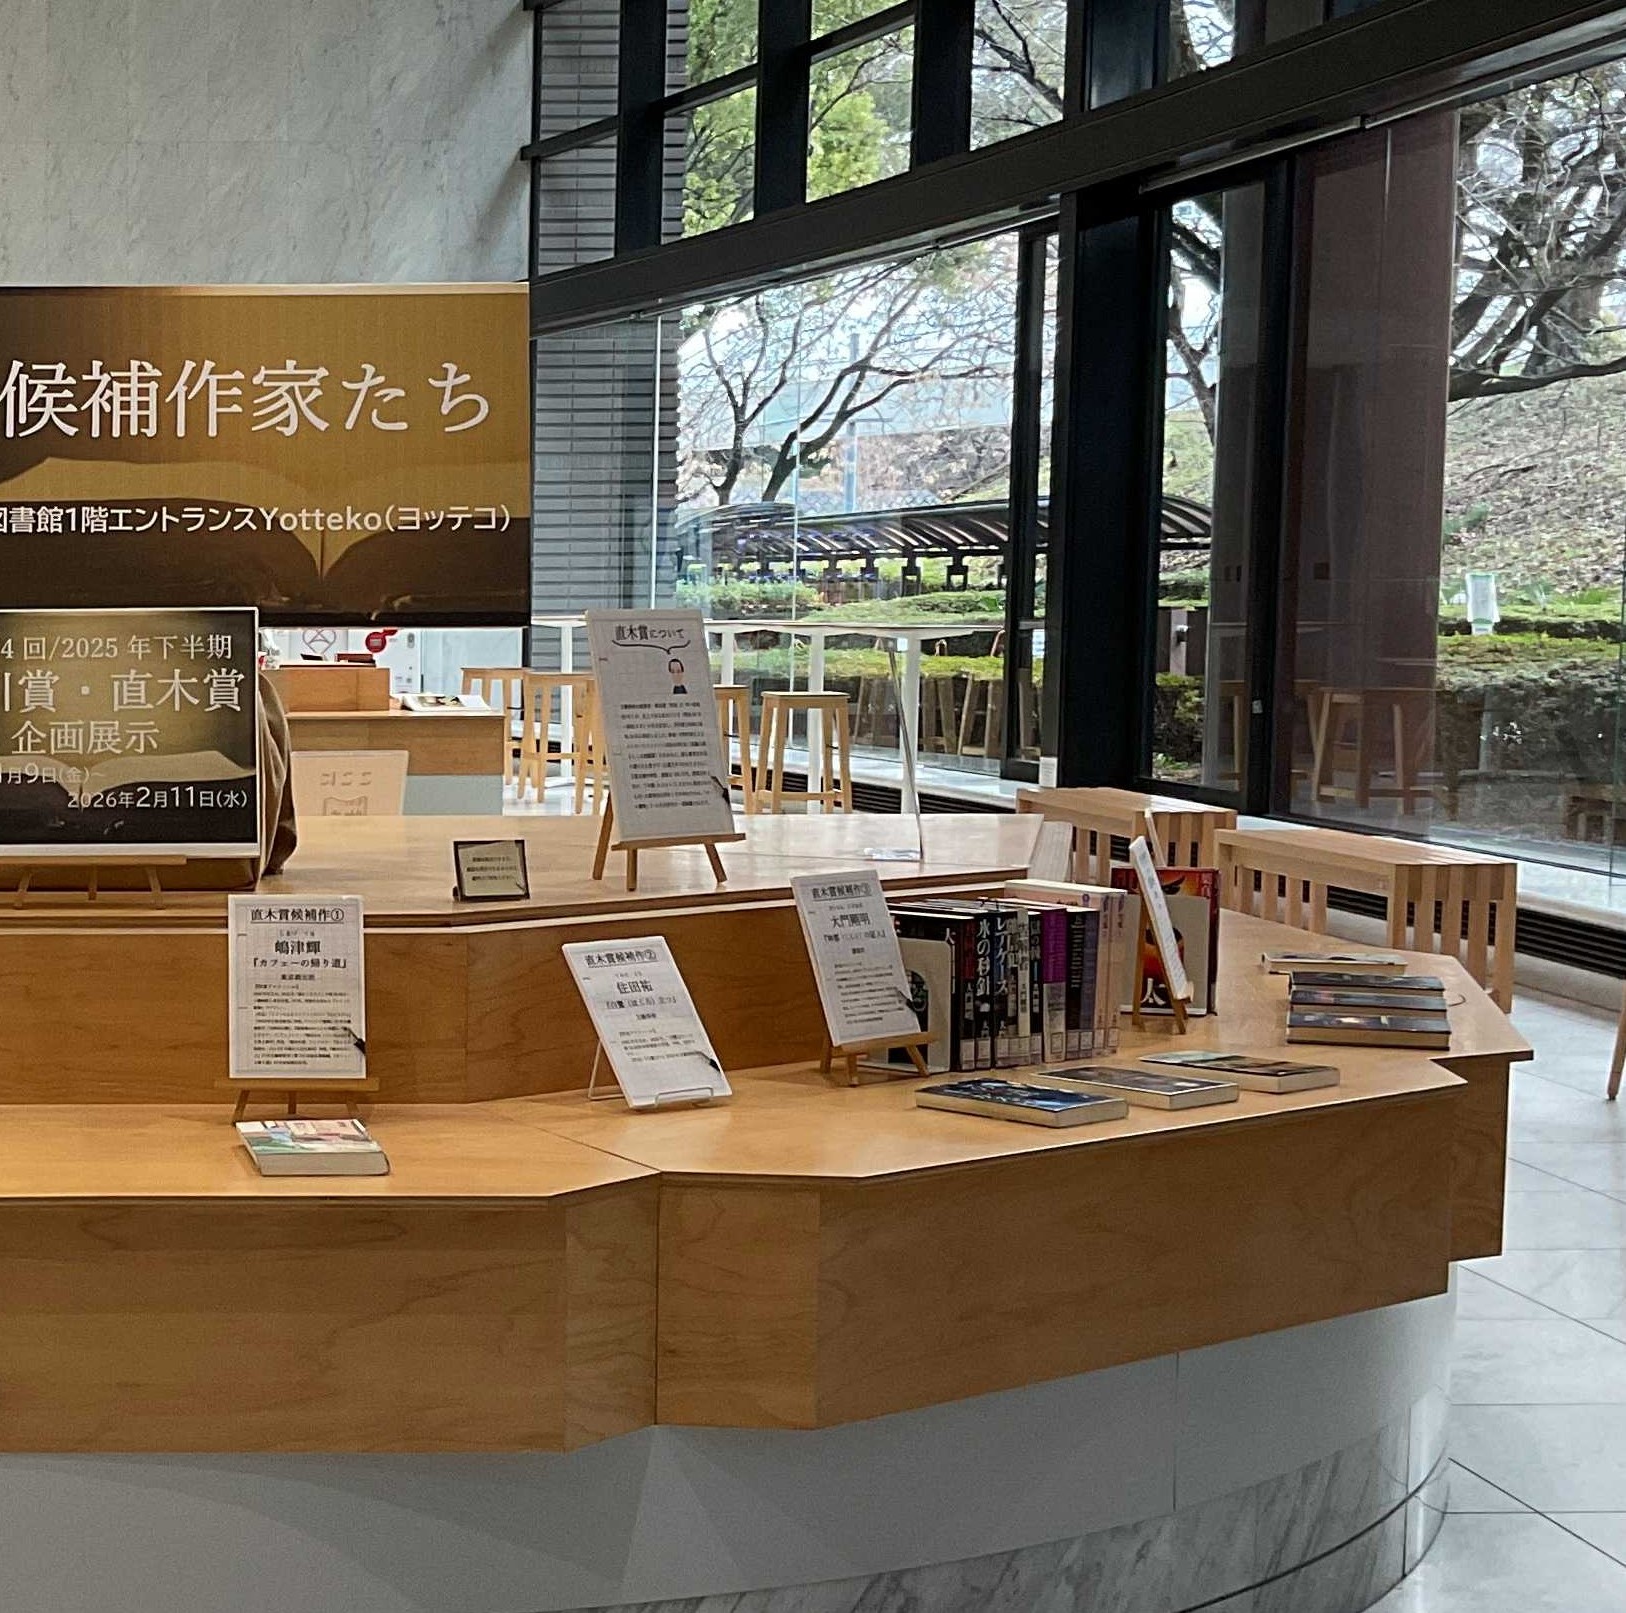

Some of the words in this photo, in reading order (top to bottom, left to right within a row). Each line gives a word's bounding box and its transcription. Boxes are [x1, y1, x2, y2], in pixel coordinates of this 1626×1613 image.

[615, 625, 685, 641] 直木賞について
[10, 720, 160, 756] 企画展示
